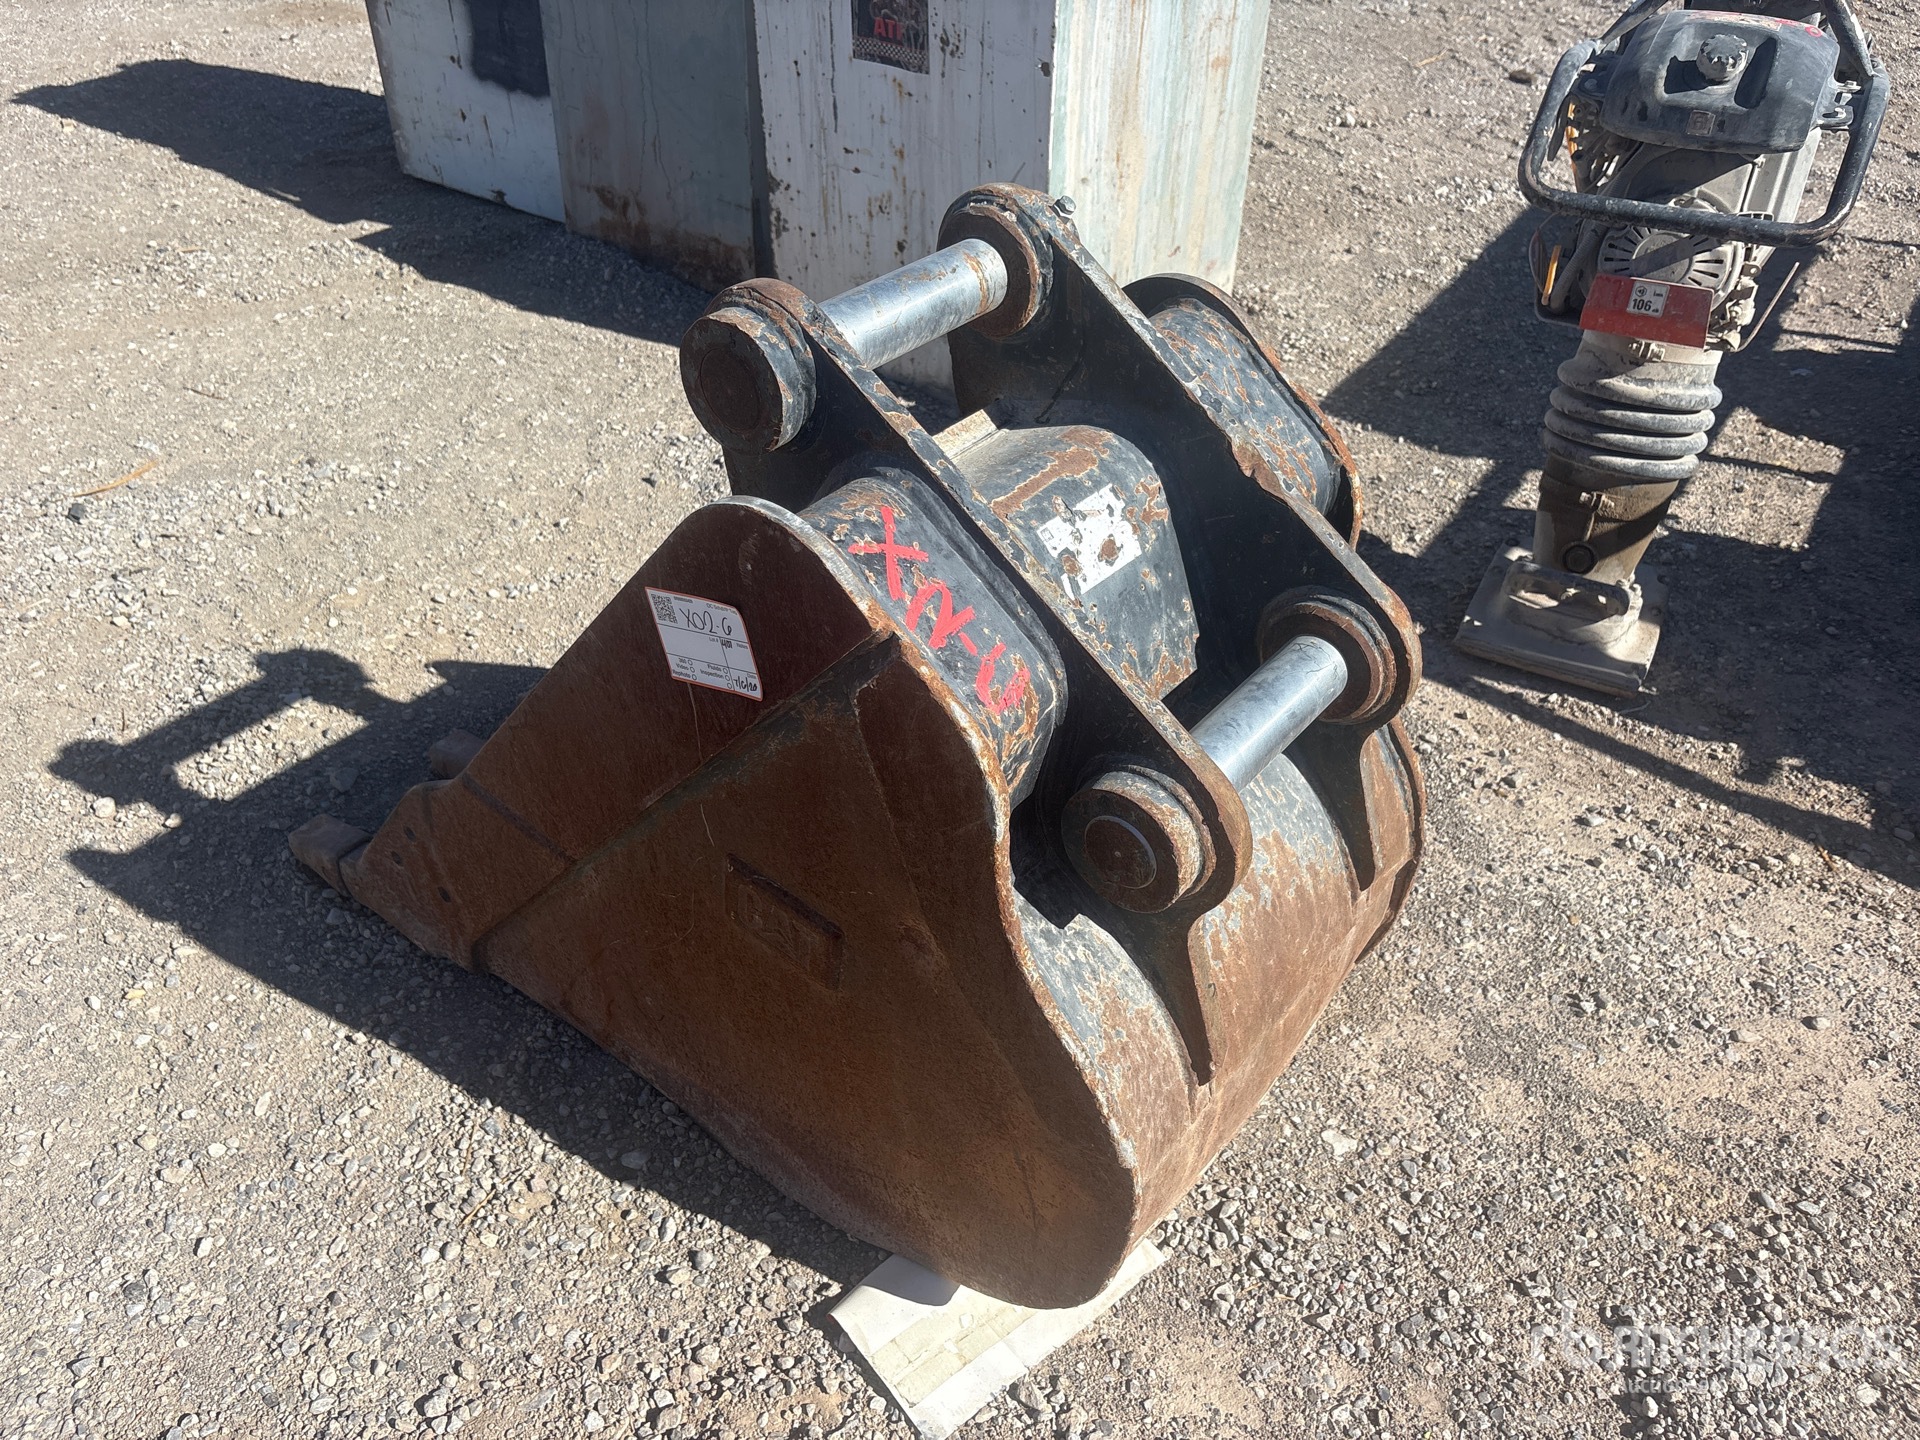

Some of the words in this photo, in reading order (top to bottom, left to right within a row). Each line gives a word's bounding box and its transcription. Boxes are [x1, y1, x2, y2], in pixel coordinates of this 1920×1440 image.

[1632, 298, 1653, 312] 106
[679, 607, 732, 636] X02-6
[699, 668, 725, 680] Inspection
[707, 663, 722, 672] Fluids
